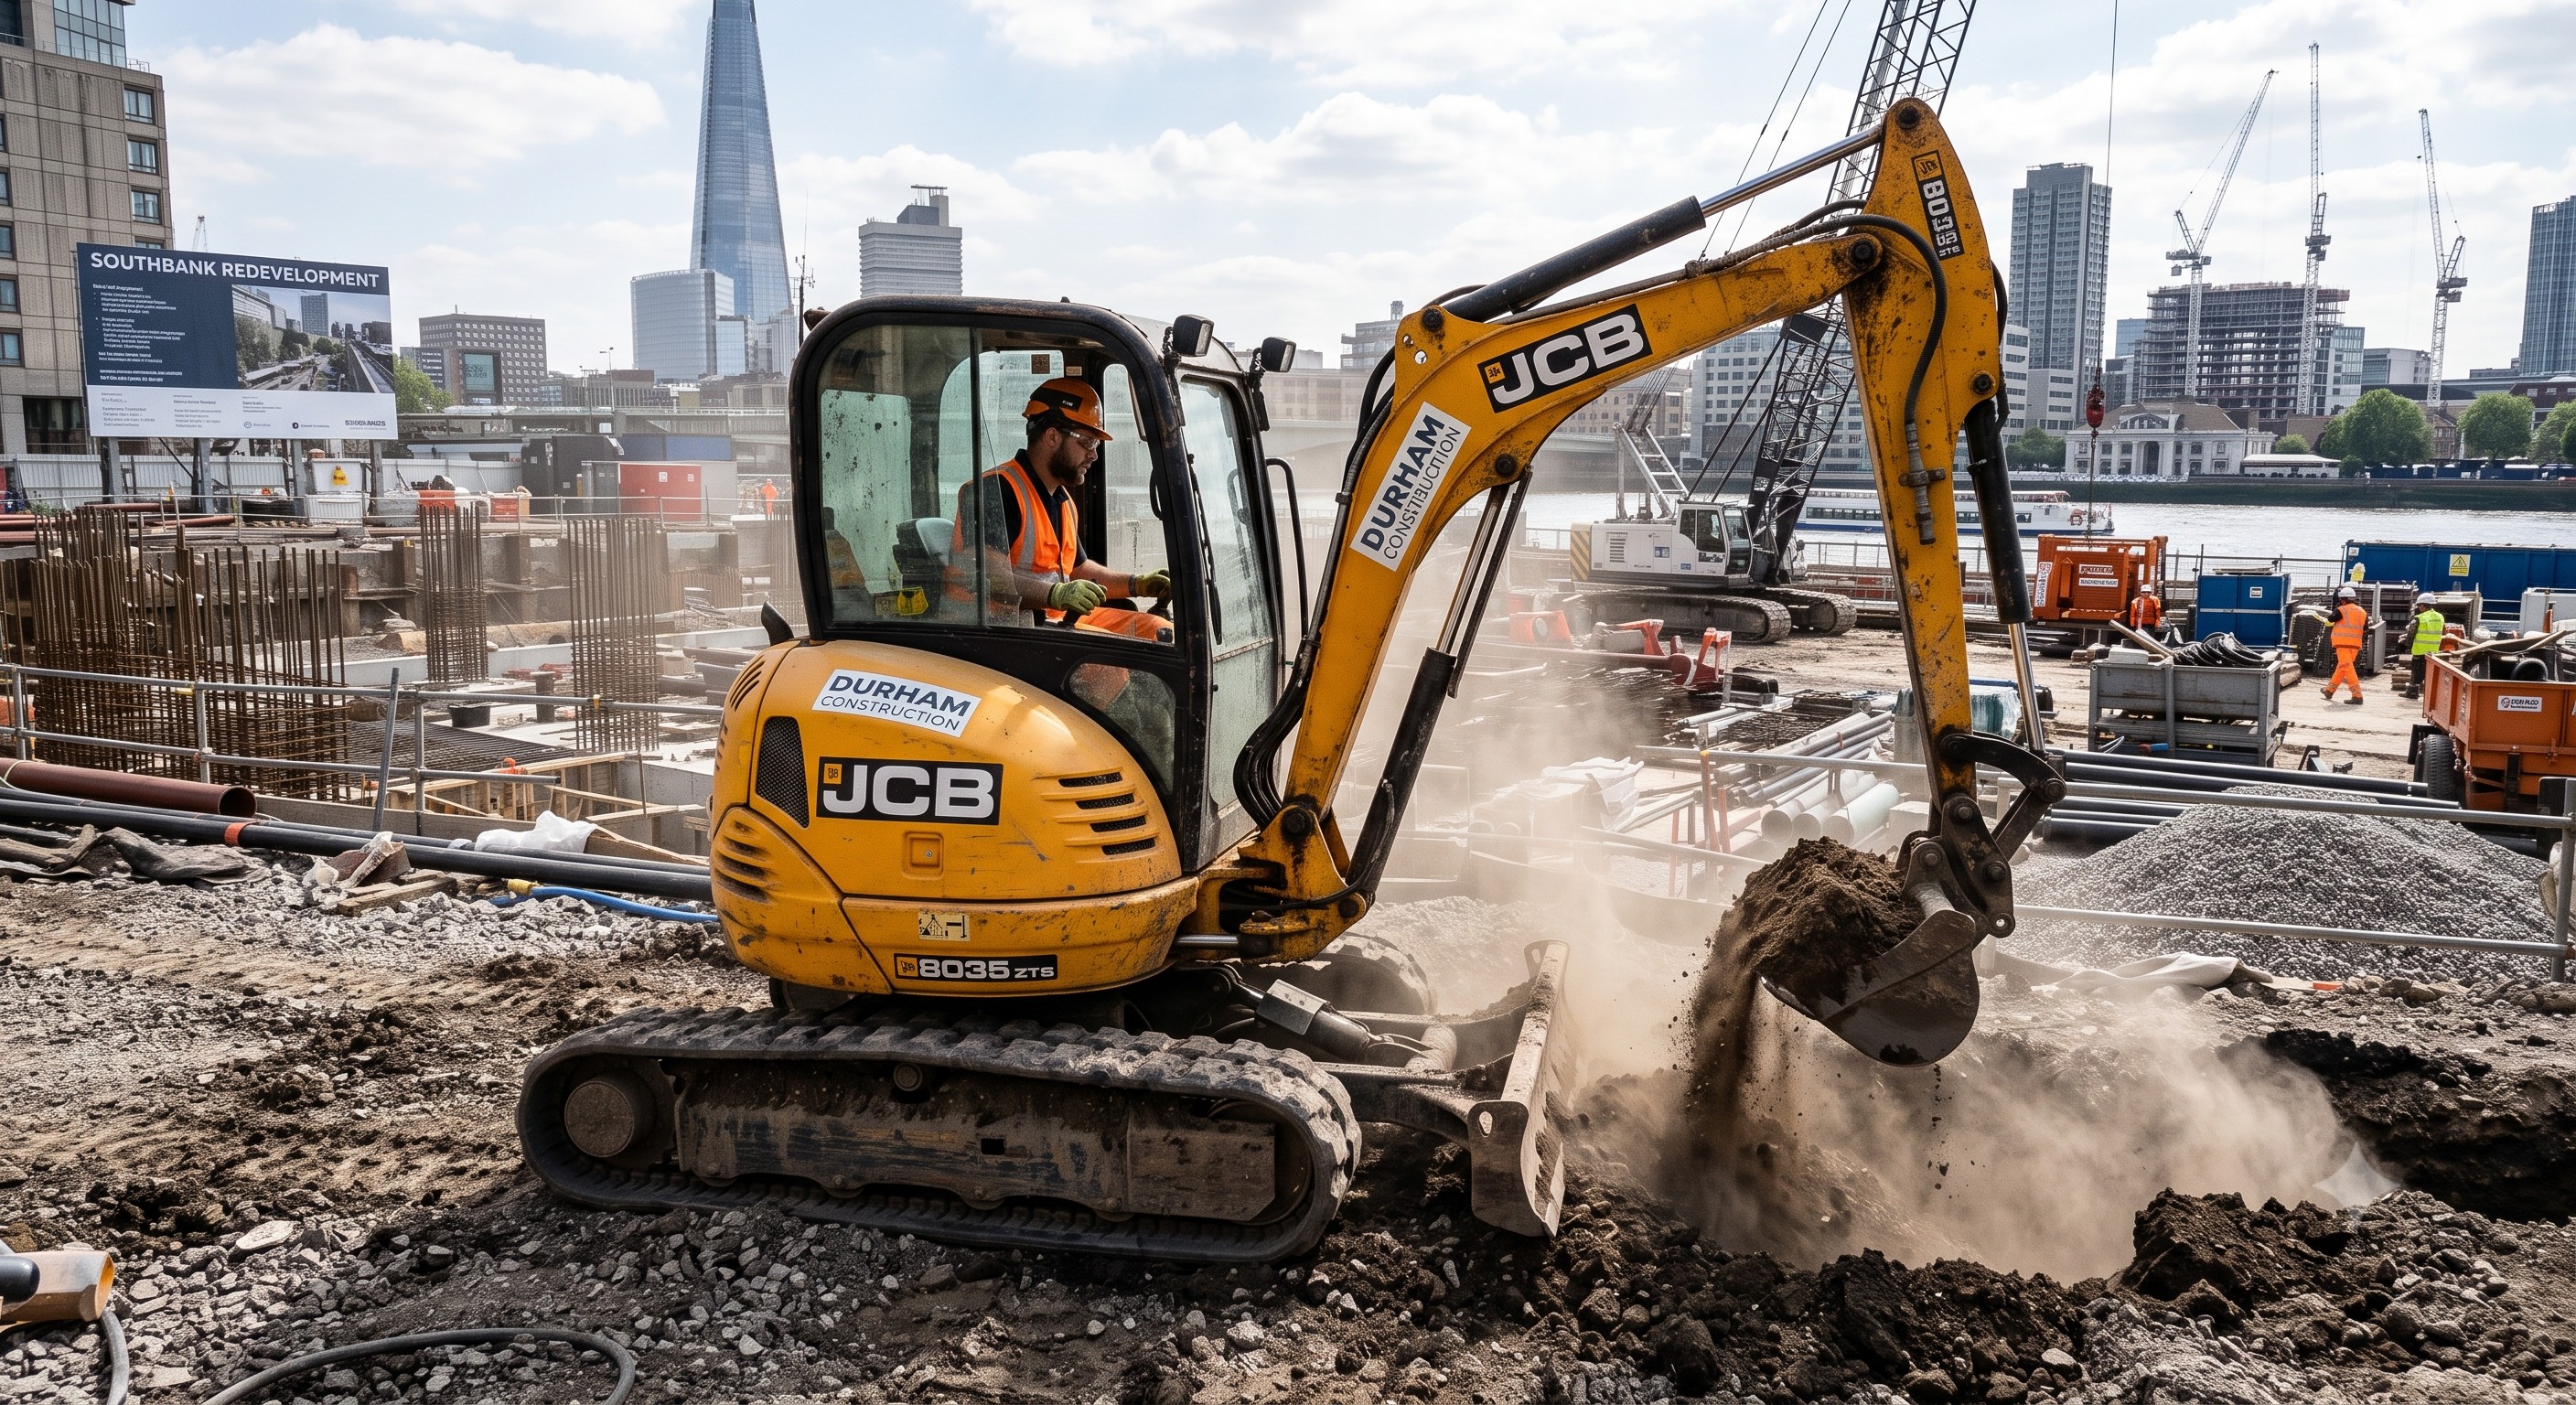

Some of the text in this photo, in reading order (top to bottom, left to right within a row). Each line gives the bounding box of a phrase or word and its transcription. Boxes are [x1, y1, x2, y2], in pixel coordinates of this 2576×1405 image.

[91, 252, 380, 288] SOUTHBANK REDEVELOPMENT
[1492, 314, 1644, 404] JCB
[1360, 414, 1445, 552] DURHAM
[821, 695, 961, 731] CONSTRUCTION
[828, 675, 971, 717] DURHAM
[823, 764, 994, 819] JCB
[919, 959, 1010, 980] 8035
[1014, 966, 1055, 979] ZTS
